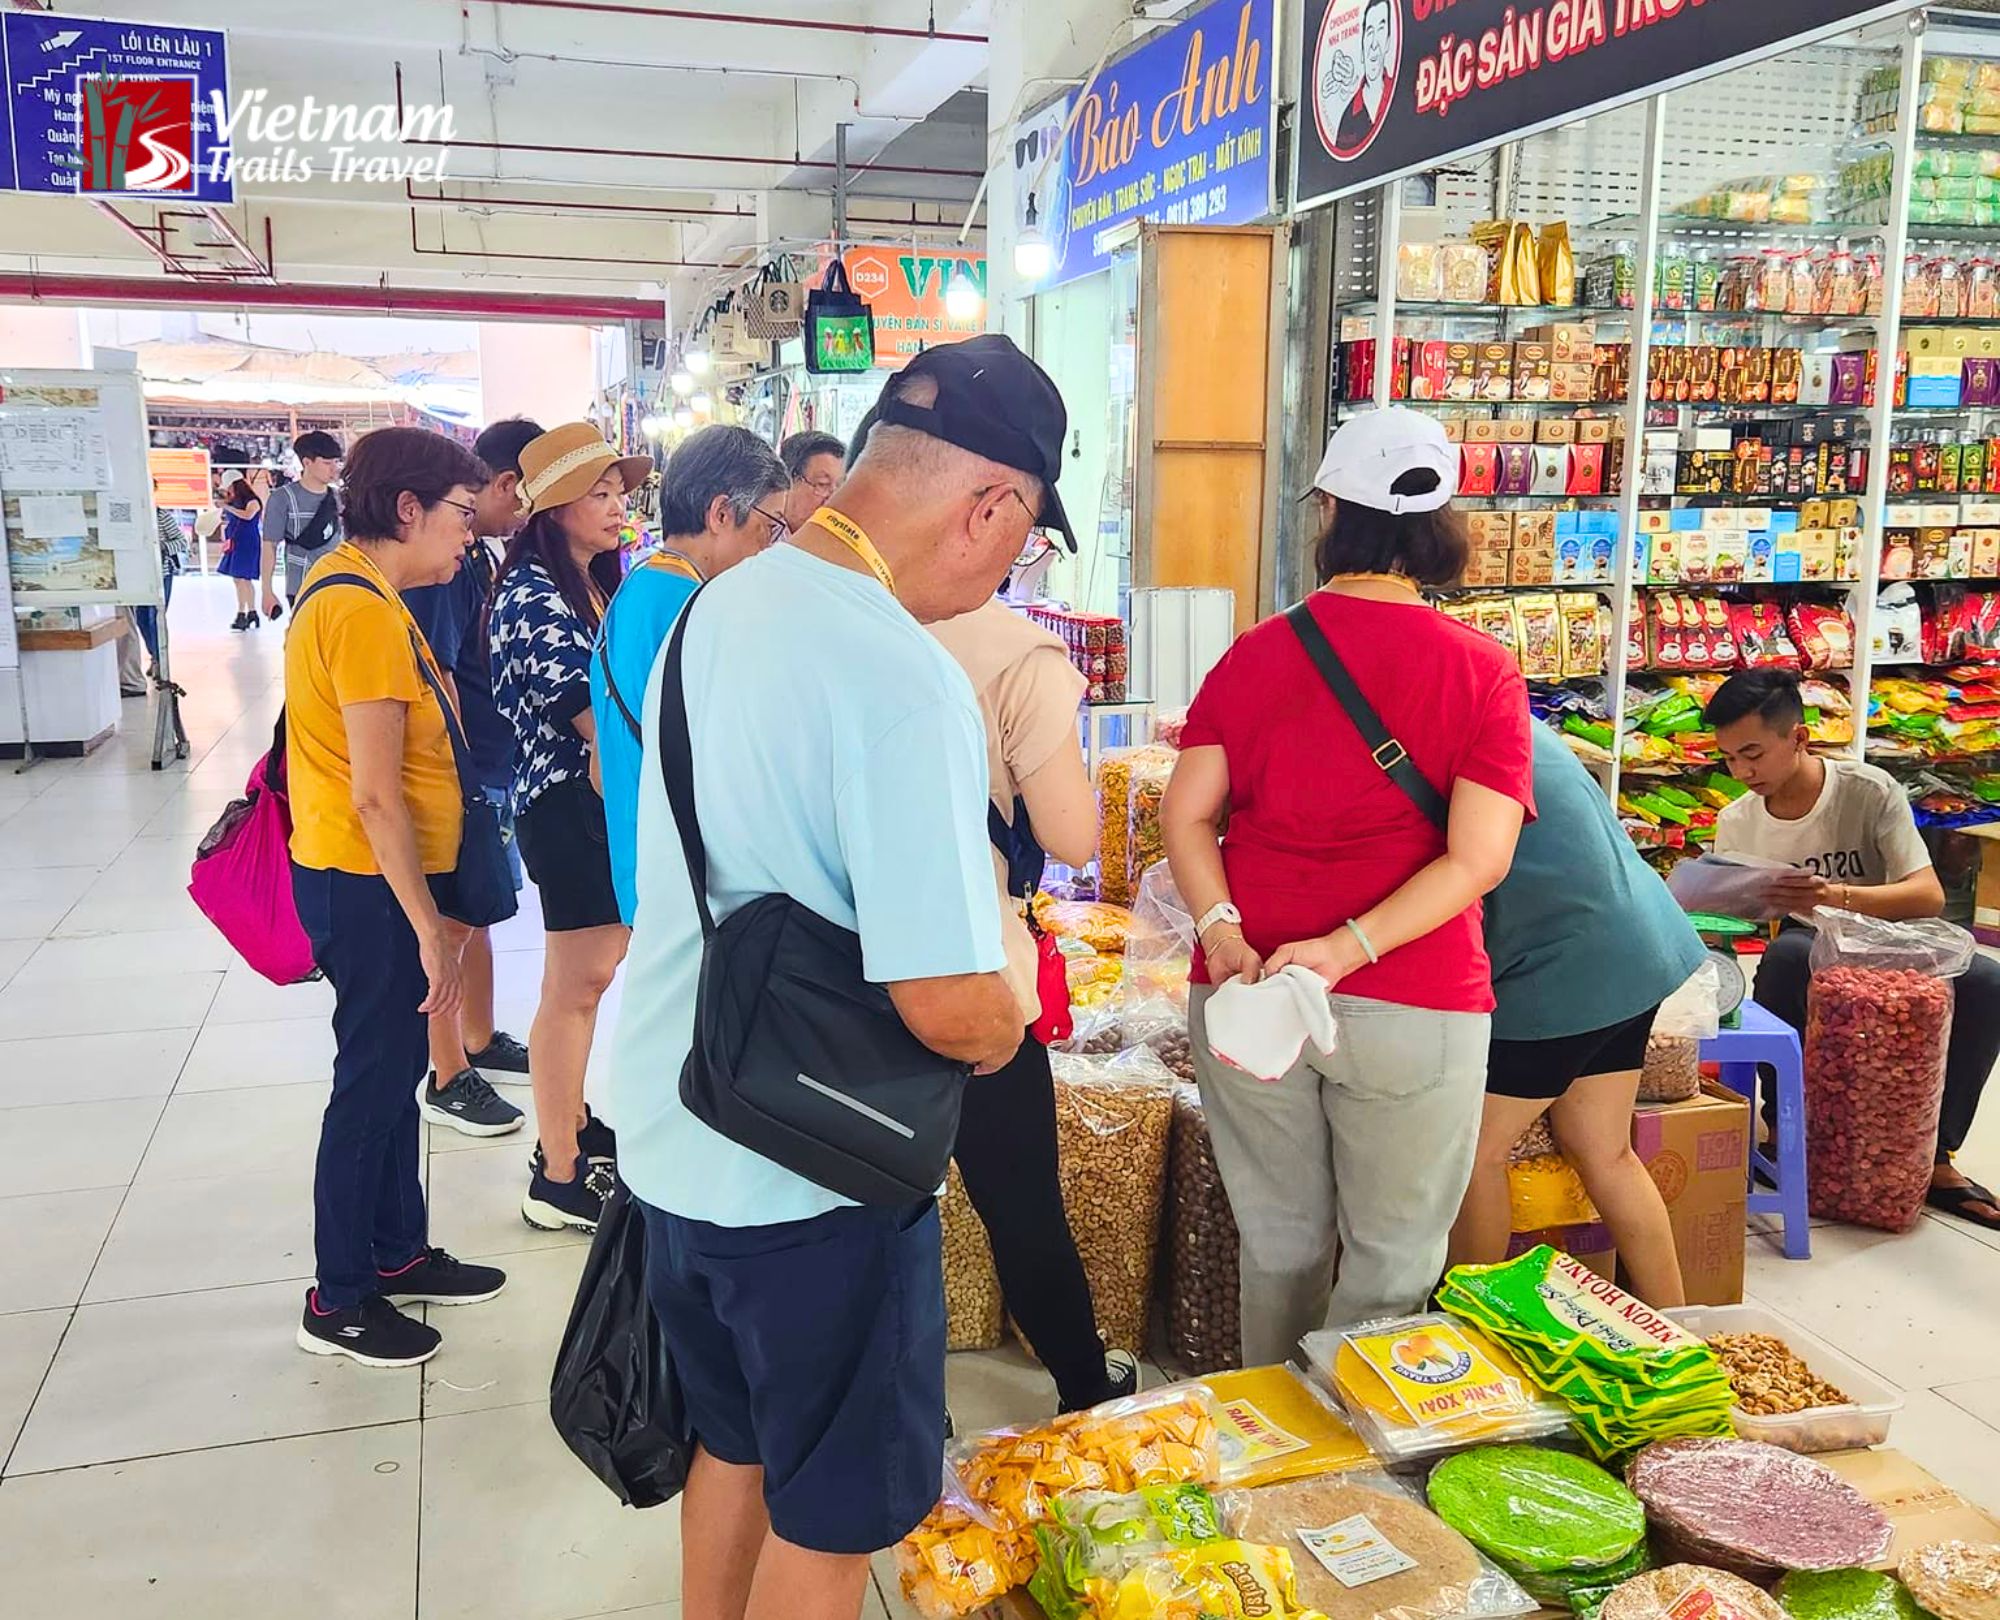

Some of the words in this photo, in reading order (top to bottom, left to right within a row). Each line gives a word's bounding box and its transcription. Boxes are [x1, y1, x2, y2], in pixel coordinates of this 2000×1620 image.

[121, 30, 142, 50] LỐI
[146, 36, 171, 53] LÊN
[175, 34, 200, 56] LẦU
[205, 43, 211, 57] 1
[108, 54, 122, 63] 1ST
[126, 56, 153, 65] FLOOR
[157, 58, 202, 70] ENTRANCE
[1416, 33, 1474, 117] ĐẶC
[1477, 7, 1543, 89] SẢN
[1072, 80, 1142, 187] Bảo
[1152, 0, 1263, 149] Anh
[1115, 178, 1138, 214] TRANG
[1188, 151, 1207, 187] TRAI
[1237, 126, 1262, 167] KÍNH
[855, 271, 886, 284] D234
[905, 314, 929, 330] BÁN
[1701, 1130, 1741, 1150] TOP
